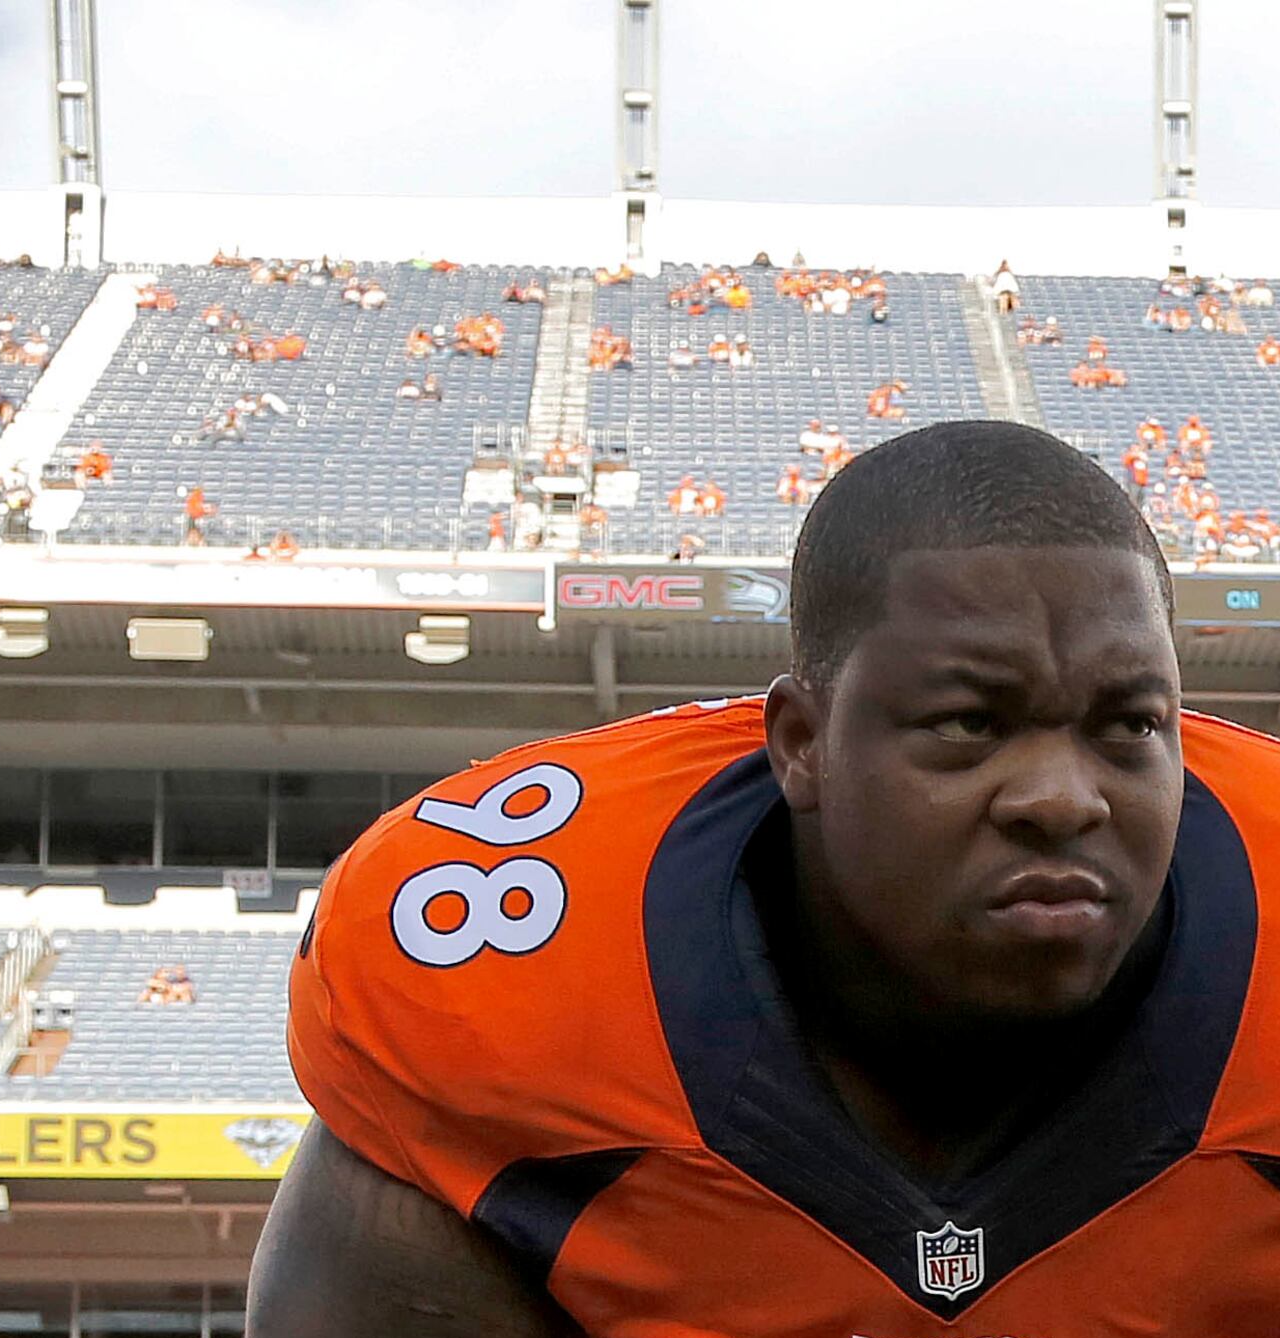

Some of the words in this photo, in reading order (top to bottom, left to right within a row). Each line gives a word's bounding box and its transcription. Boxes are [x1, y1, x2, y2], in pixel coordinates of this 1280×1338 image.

[558, 574, 704, 611] GMC
[389, 762, 584, 968] 98
[928, 1256, 974, 1288] NFL
